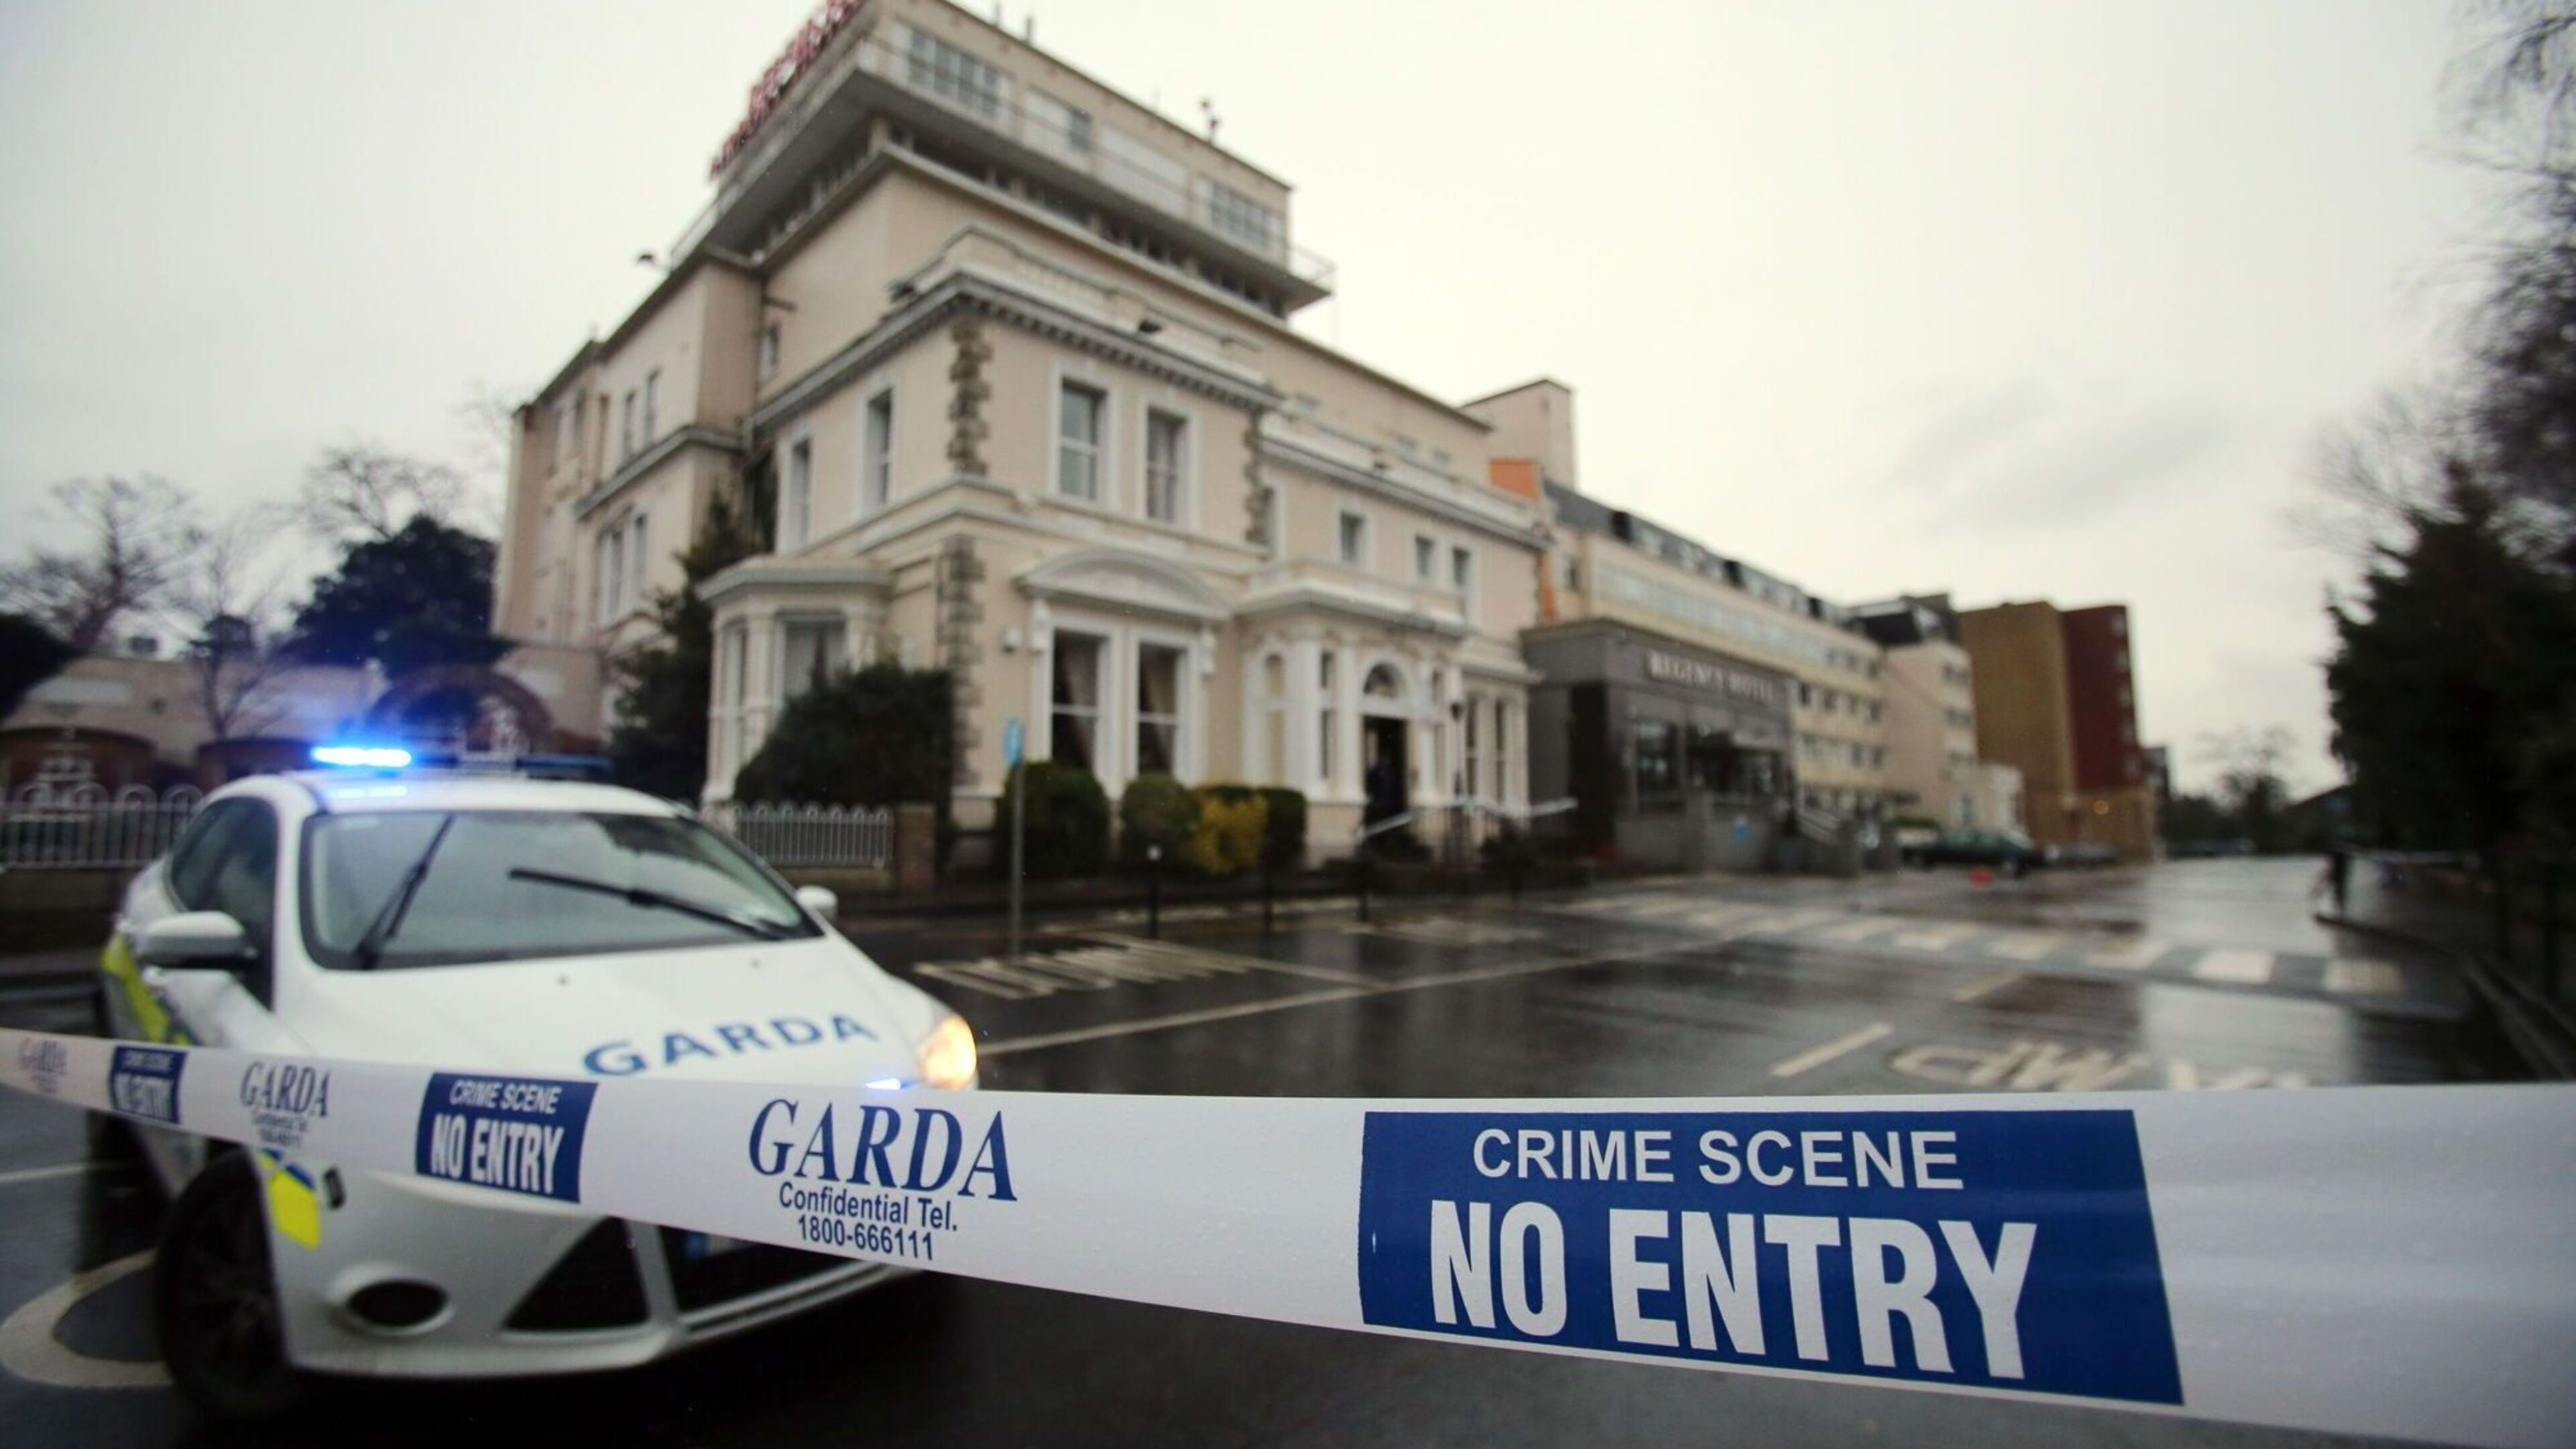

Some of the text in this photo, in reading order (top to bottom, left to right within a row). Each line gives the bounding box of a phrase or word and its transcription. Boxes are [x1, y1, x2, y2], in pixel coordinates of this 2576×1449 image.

[584, 1014, 877, 1075] GARDA
[239, 1062, 330, 1117] GARDA
[449, 1079, 561, 1114] CRIME SCENE
[430, 1114, 564, 1194] NO ENTRY
[749, 1099, 1017, 1201] GARDA
[1474, 1129, 1964, 1189] CRIME SCENE
[780, 1182, 957, 1231] Confidential Tel.
[798, 1215, 933, 1260] 1800-666111
[1432, 1199, 2037, 1379] NO ENTRY
